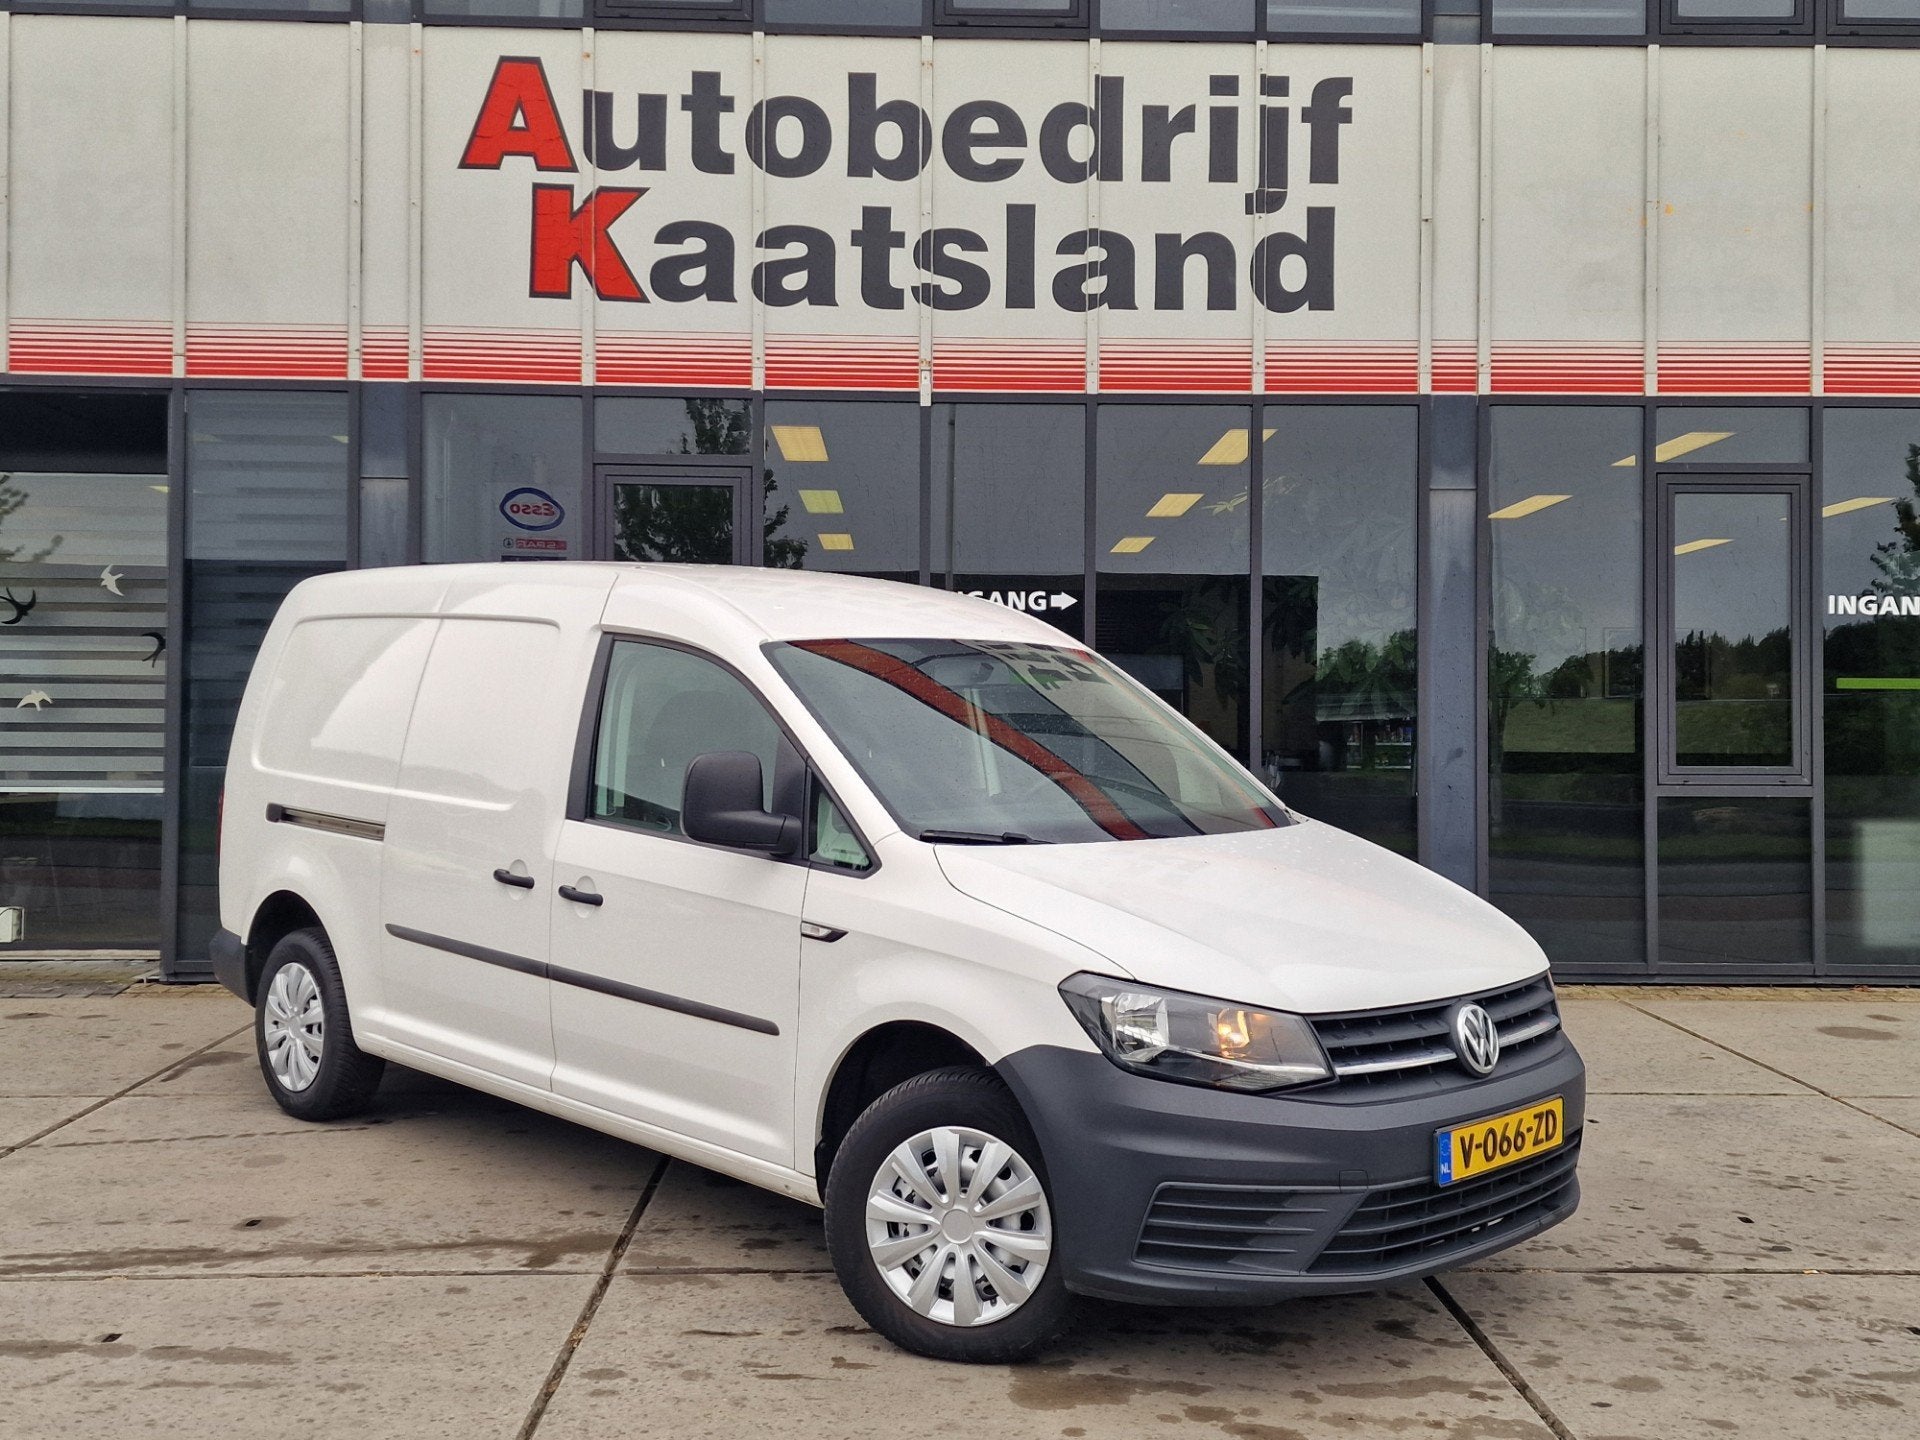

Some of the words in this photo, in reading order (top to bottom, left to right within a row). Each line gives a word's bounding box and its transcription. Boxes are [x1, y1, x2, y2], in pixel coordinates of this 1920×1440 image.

[457, 55, 1354, 216] Autobedrijf
[528, 182, 1336, 314] Kaatsland
[1828, 594, 1920, 616] INGAN
[1440, 1163, 1451, 1175] NL
[1459, 1108, 1558, 1170] V-066-ZD
